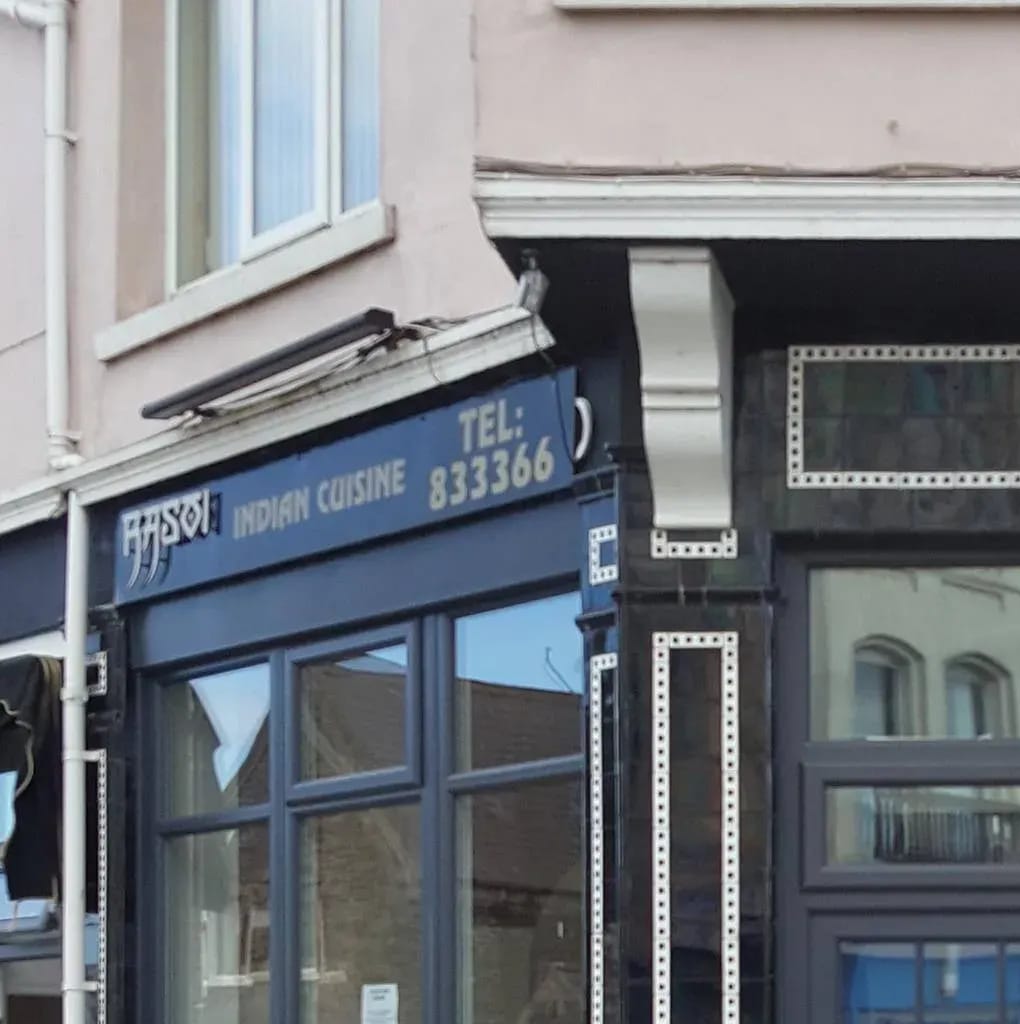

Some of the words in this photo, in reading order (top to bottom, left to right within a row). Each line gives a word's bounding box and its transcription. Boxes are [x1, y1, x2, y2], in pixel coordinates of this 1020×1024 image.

[459, 399, 524, 452] TEL:
[232, 486, 309, 539] INDIAN
[316, 459, 406, 514] CUISINE
[430, 436, 555, 510] 833366
